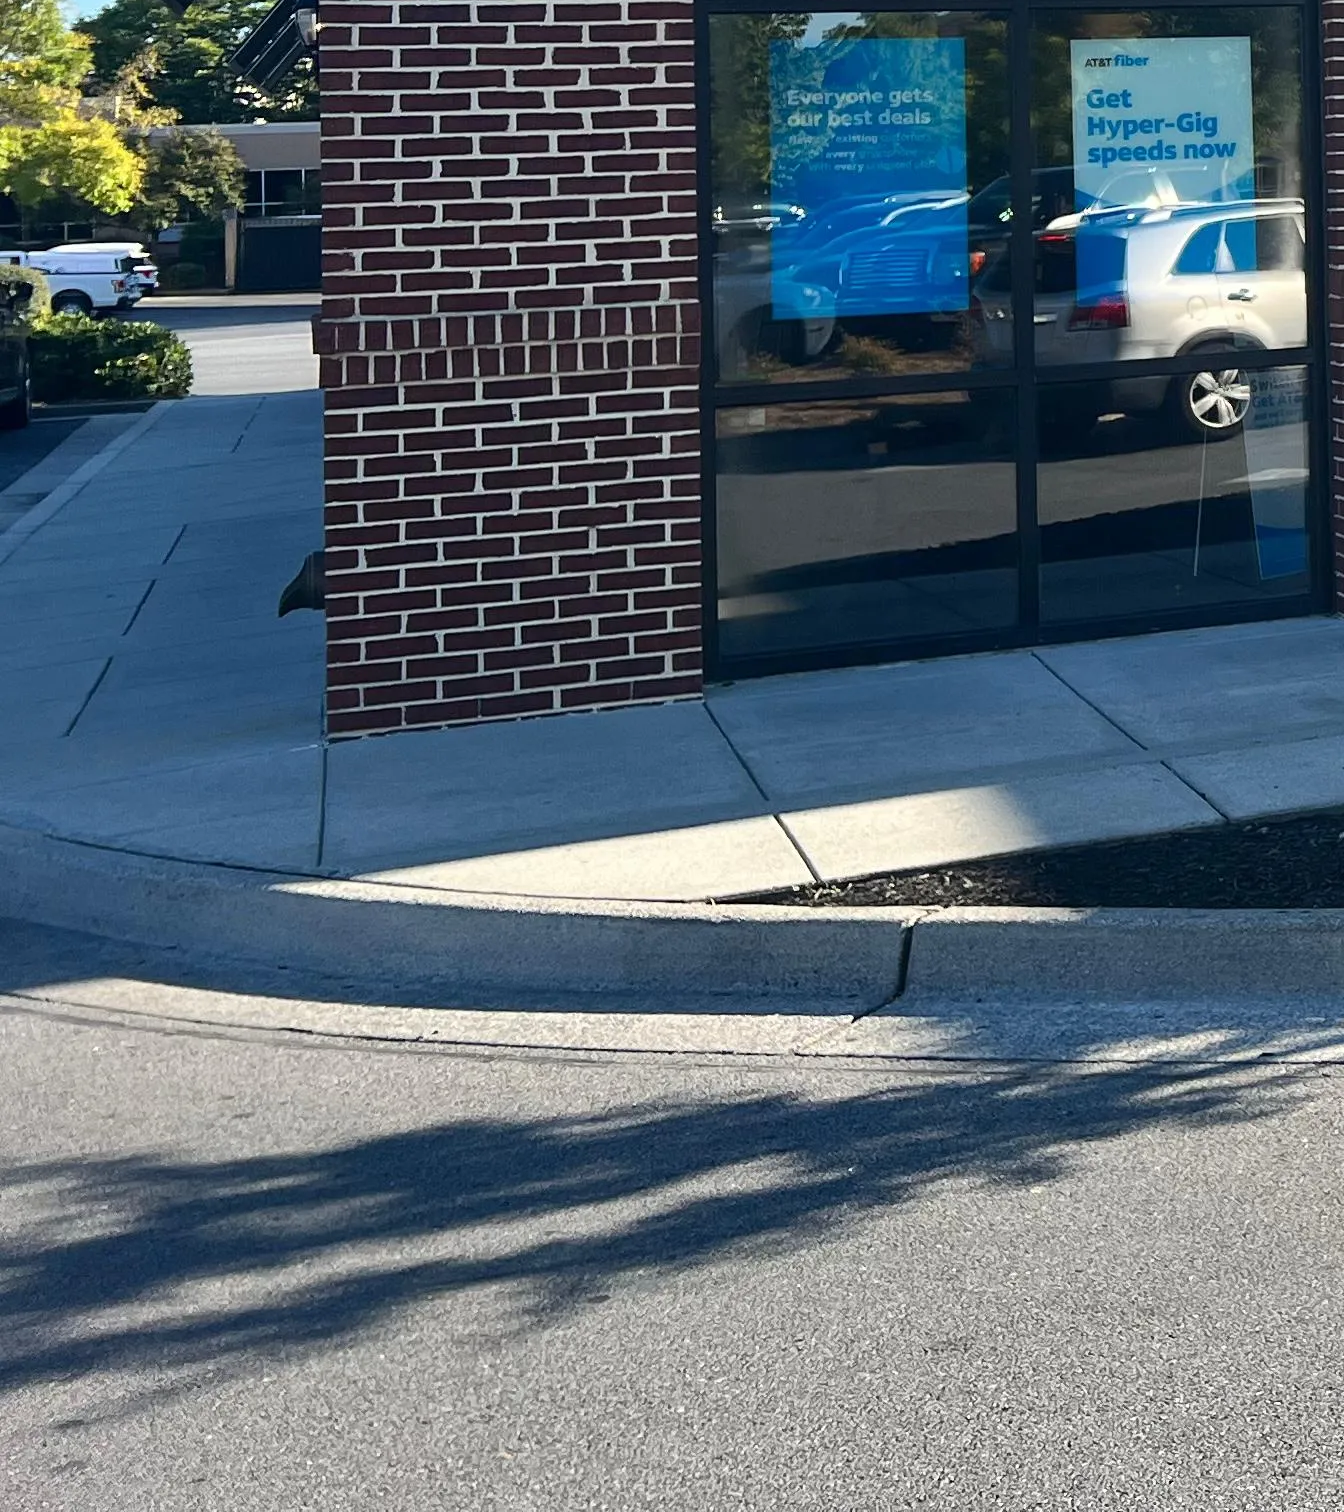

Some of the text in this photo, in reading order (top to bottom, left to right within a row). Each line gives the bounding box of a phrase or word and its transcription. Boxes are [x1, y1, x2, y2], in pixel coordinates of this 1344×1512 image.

[1085, 54, 1149, 68] AT&T fiber
[787, 88, 934, 109] Everyone gets
[1086, 89, 1133, 109] Get
[787, 108, 931, 128] our best deals
[1087, 111, 1218, 141] Hyper-Gig
[1088, 139, 1237, 169] speeds now
